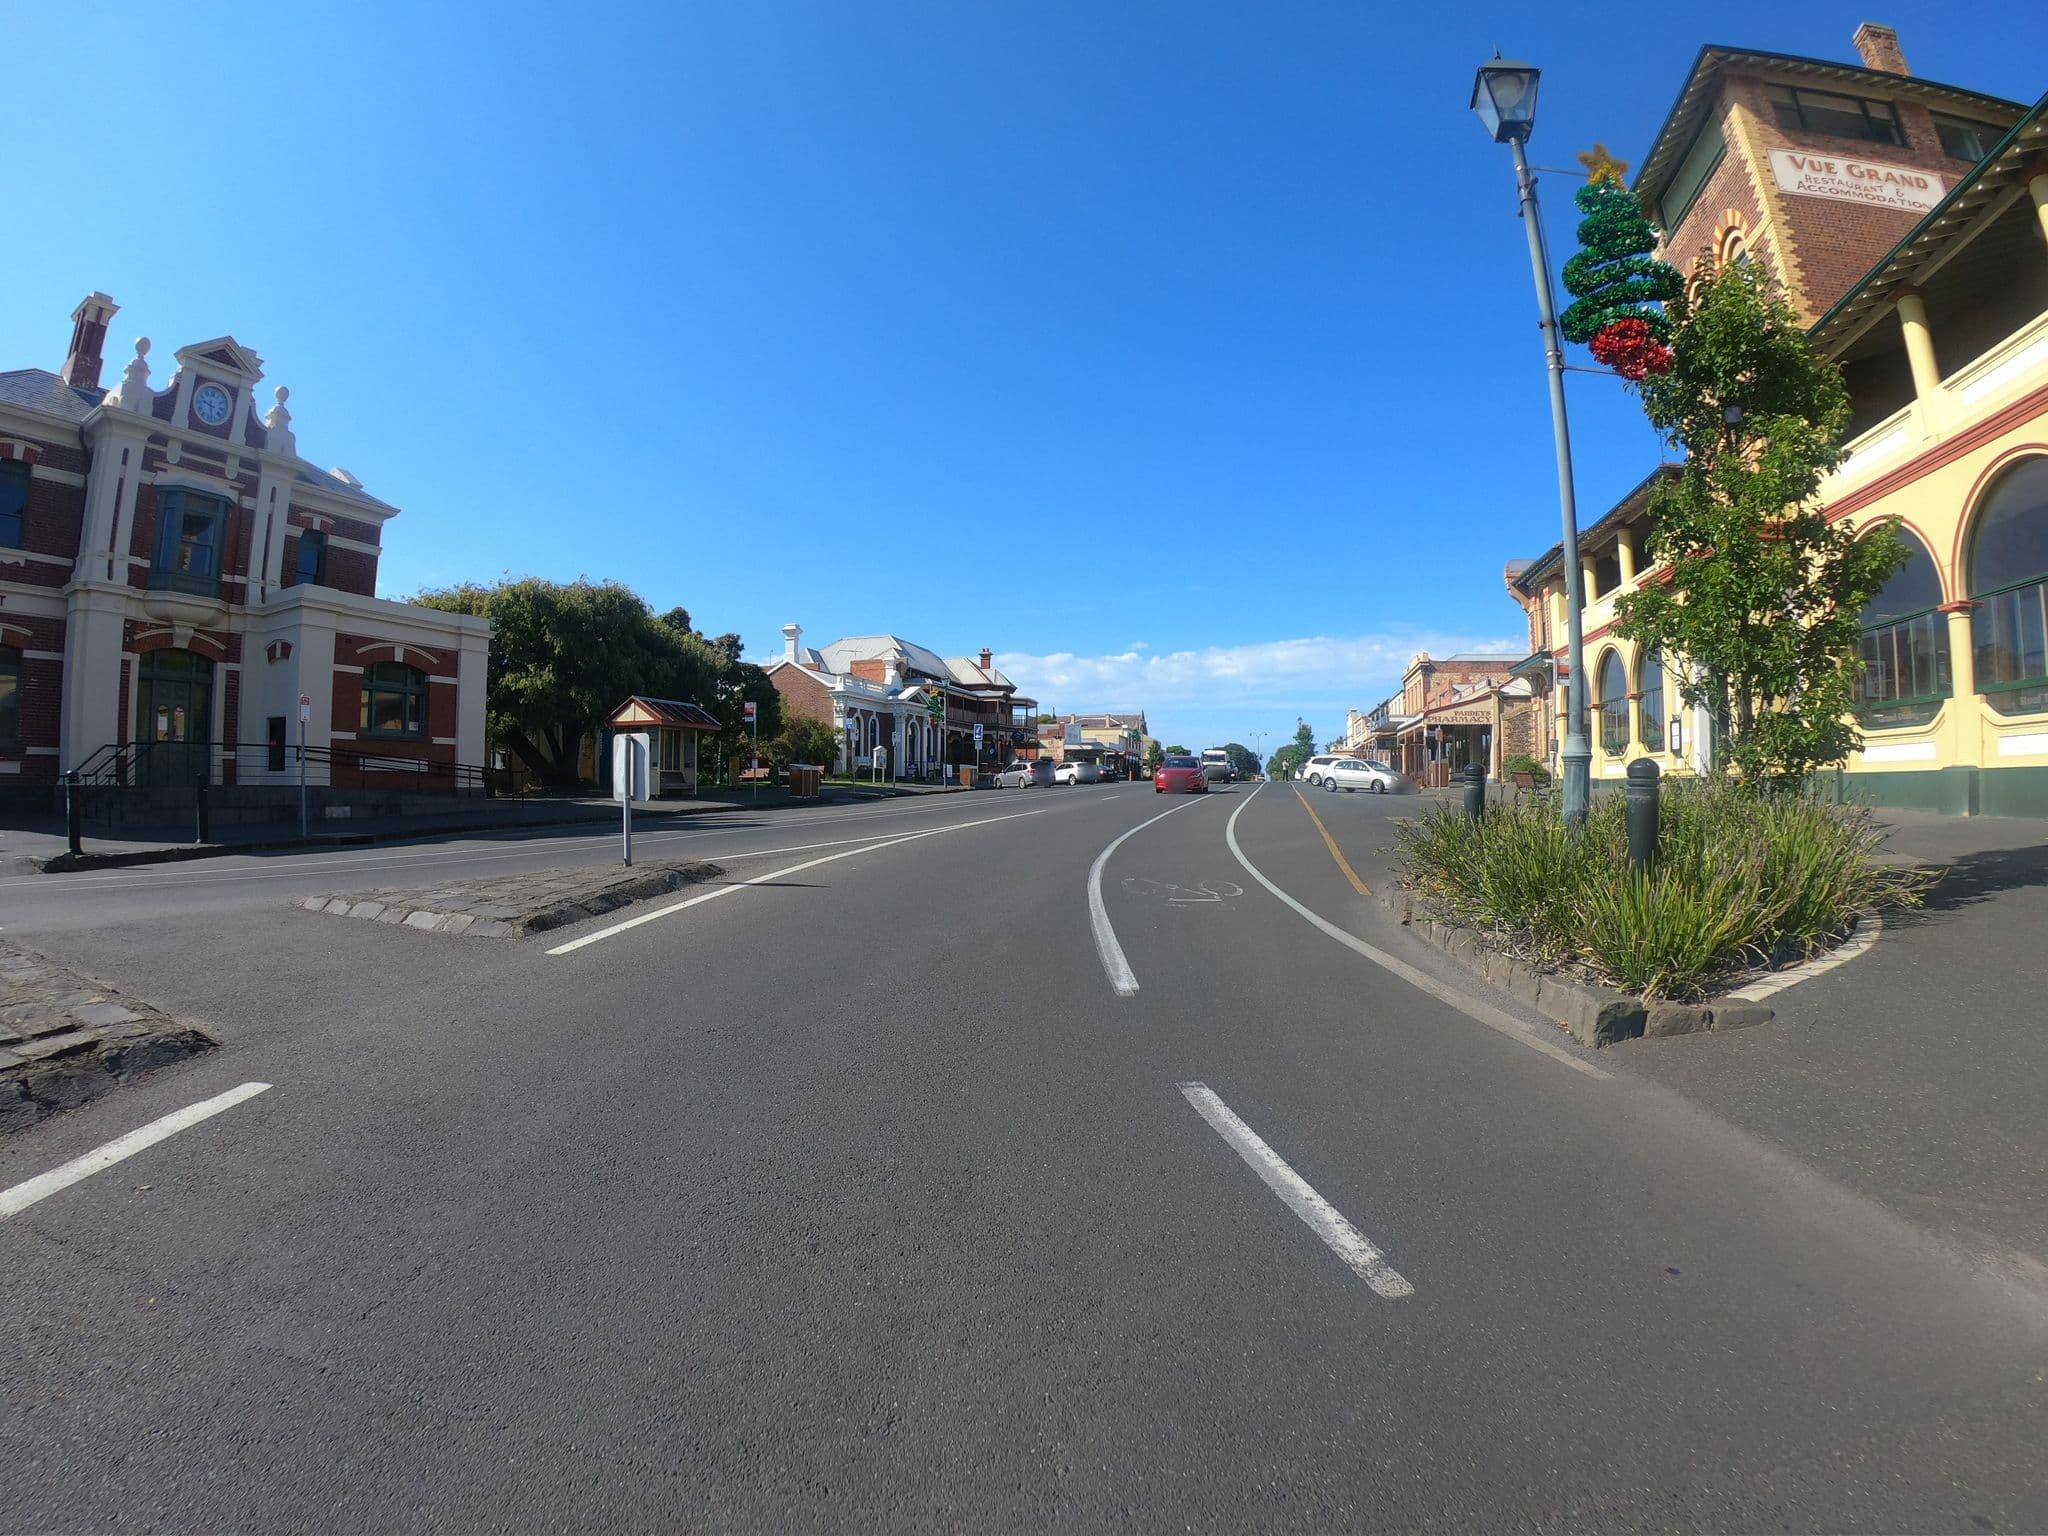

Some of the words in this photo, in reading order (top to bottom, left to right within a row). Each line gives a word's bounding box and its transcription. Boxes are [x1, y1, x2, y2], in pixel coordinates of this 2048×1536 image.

[1787, 154, 1838, 175] VUE
[1845, 163, 1929, 190] GRAND
[1804, 174, 1884, 193] RESTAURANT
[1895, 188, 1905, 198] &
[1796, 180, 1934, 210] ACCOMMODATION
